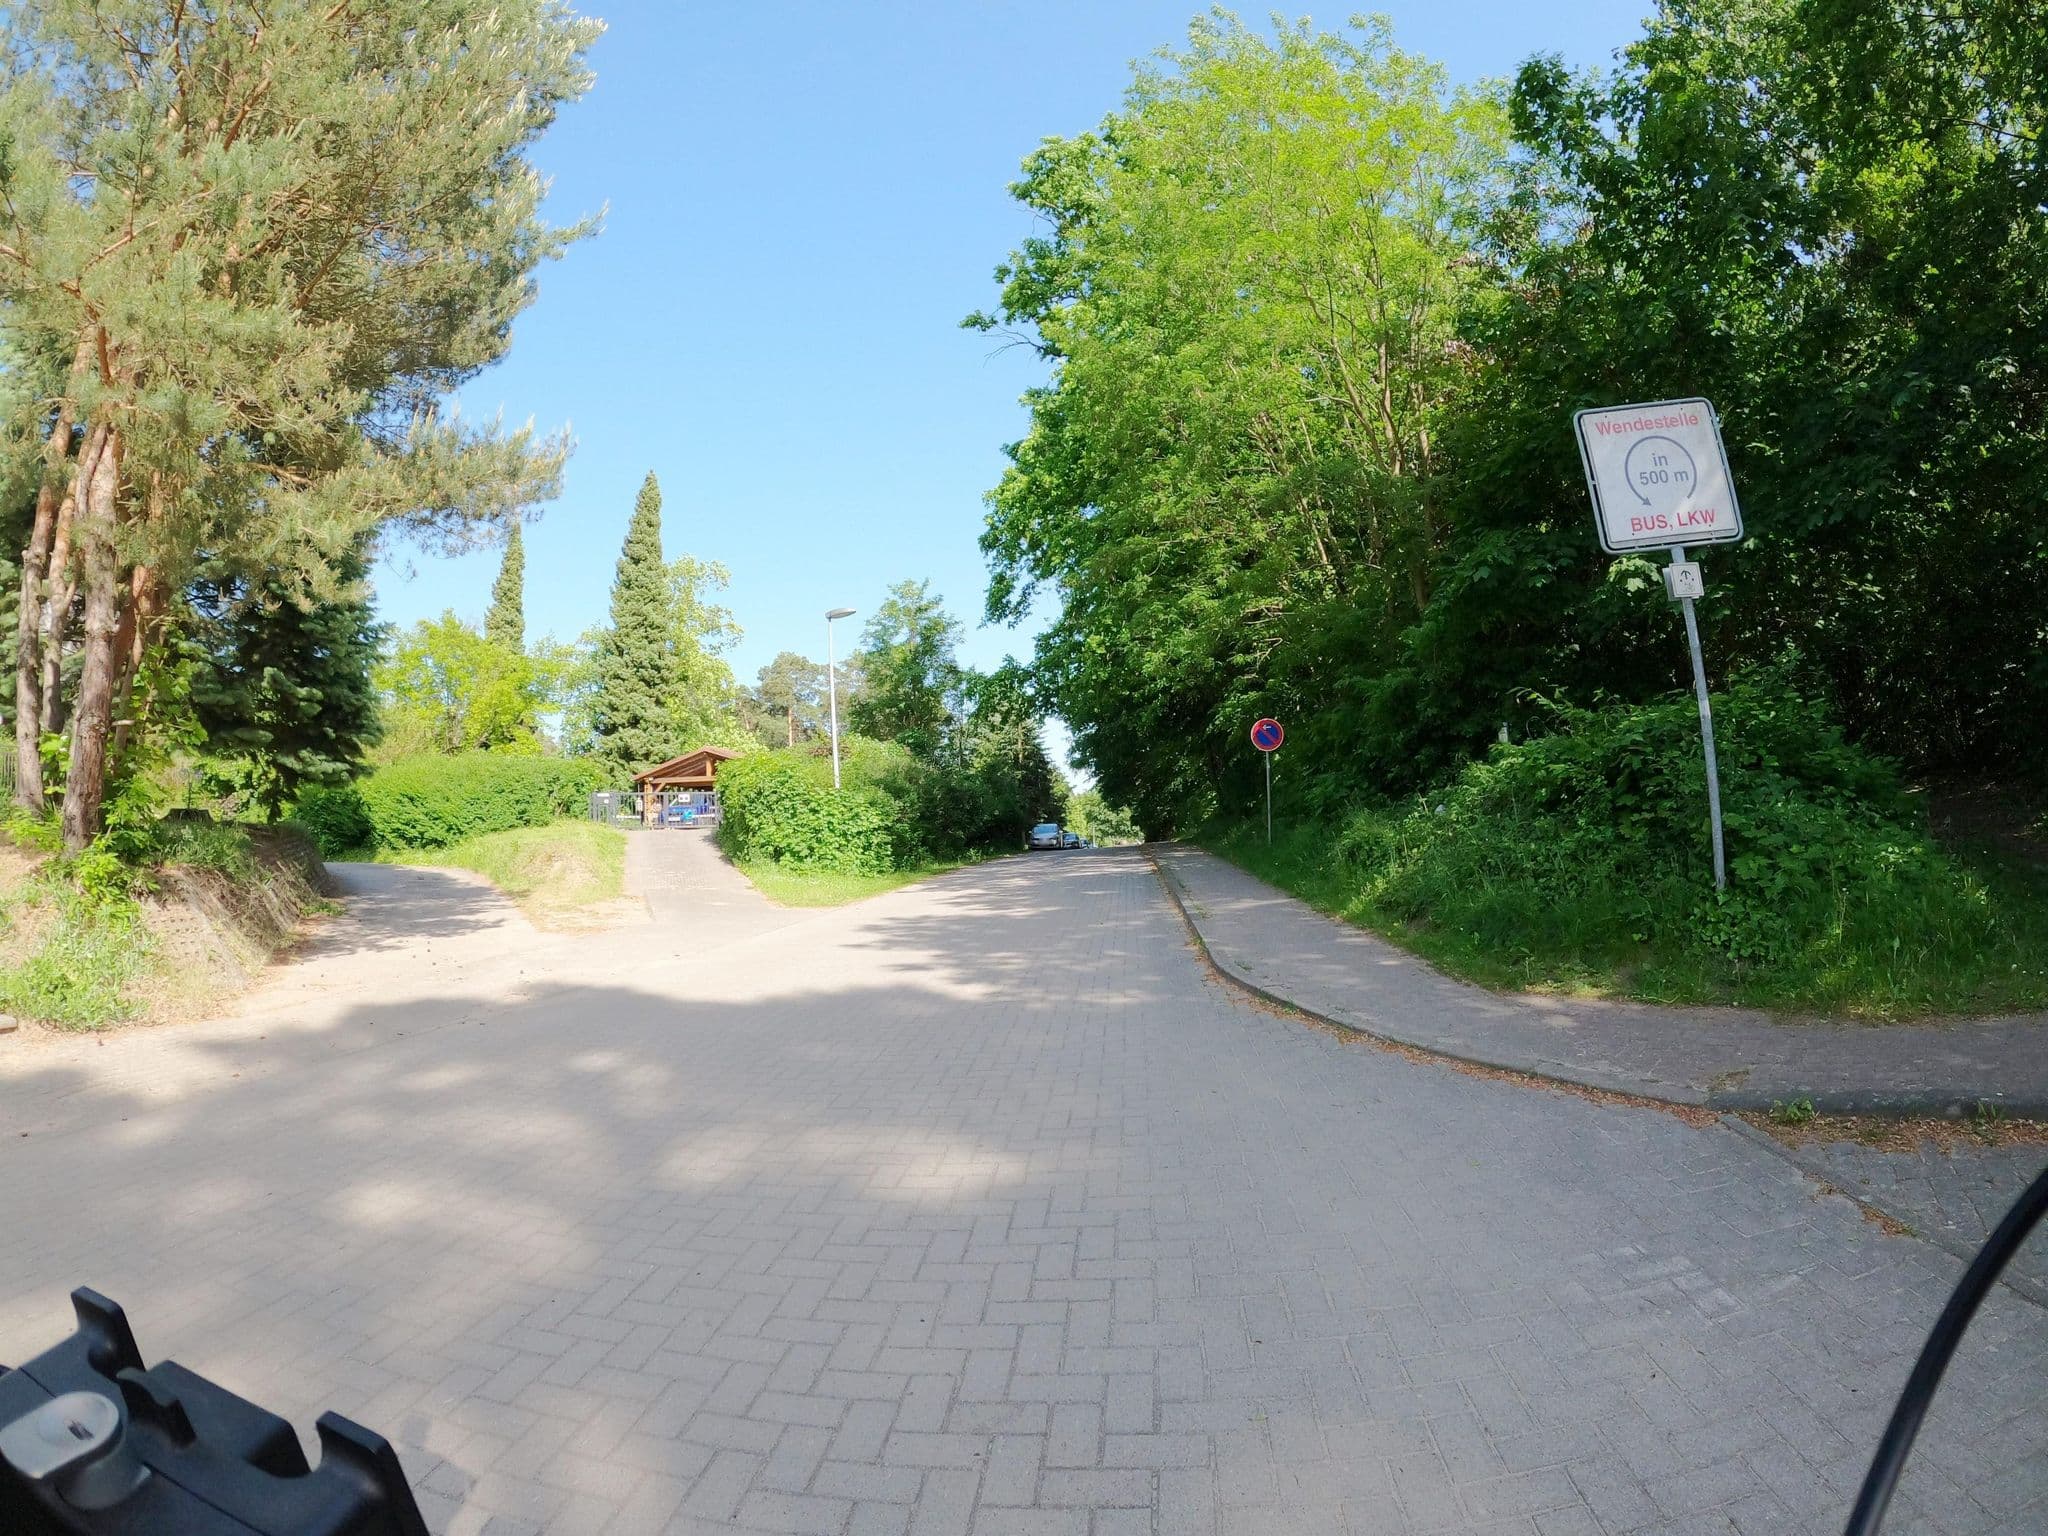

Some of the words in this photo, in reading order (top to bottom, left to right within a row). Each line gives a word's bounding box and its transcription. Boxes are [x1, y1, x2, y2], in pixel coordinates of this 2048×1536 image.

[1595, 412, 1699, 436] Wendestelle
[1652, 453, 1668, 467] in
[1639, 469, 1669, 485] 500
[1674, 468, 1689, 482] m
[1631, 513, 1674, 532] BUS,
[1677, 508, 1716, 527] LKW
